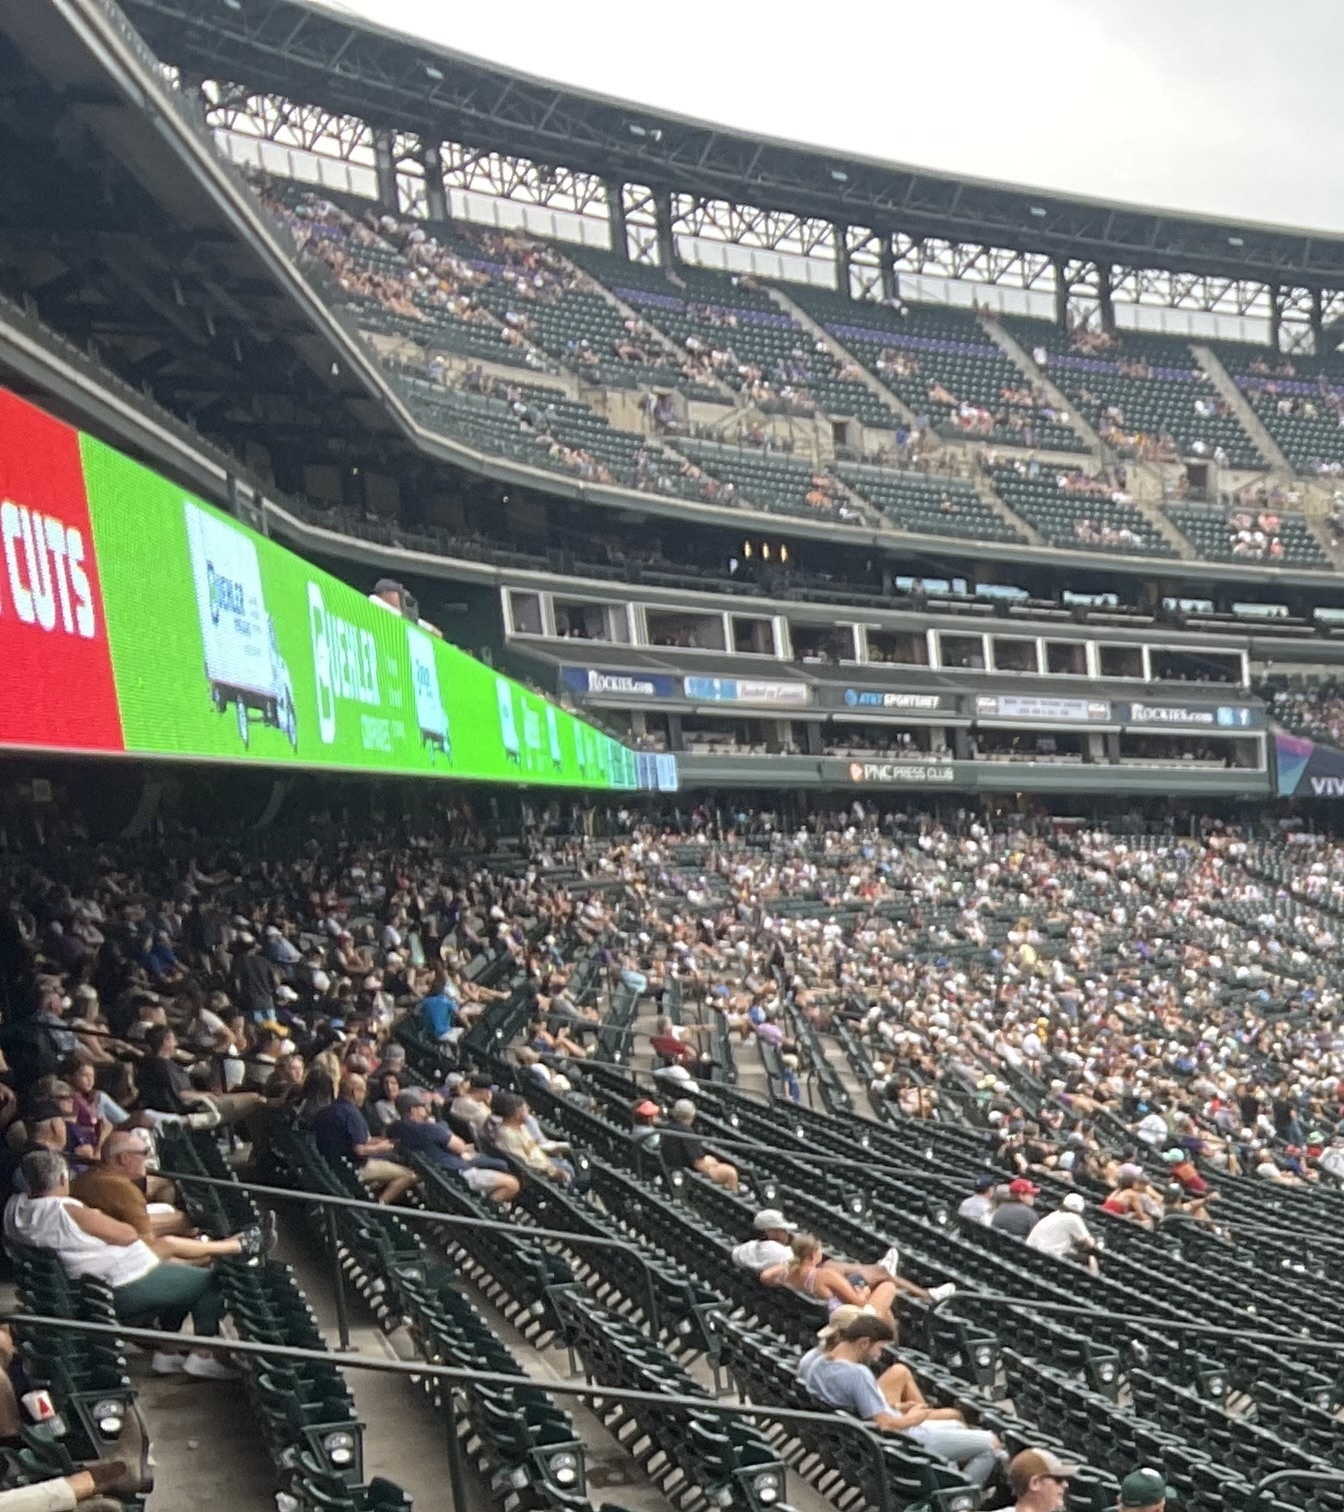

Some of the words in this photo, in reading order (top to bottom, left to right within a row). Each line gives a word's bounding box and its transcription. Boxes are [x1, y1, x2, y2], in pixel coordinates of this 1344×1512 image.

[1, 498, 96, 639] CUTS
[864, 764, 892, 781] PNC
[893, 765, 926, 781] PRESS
[927, 766, 955, 781] CLUB
